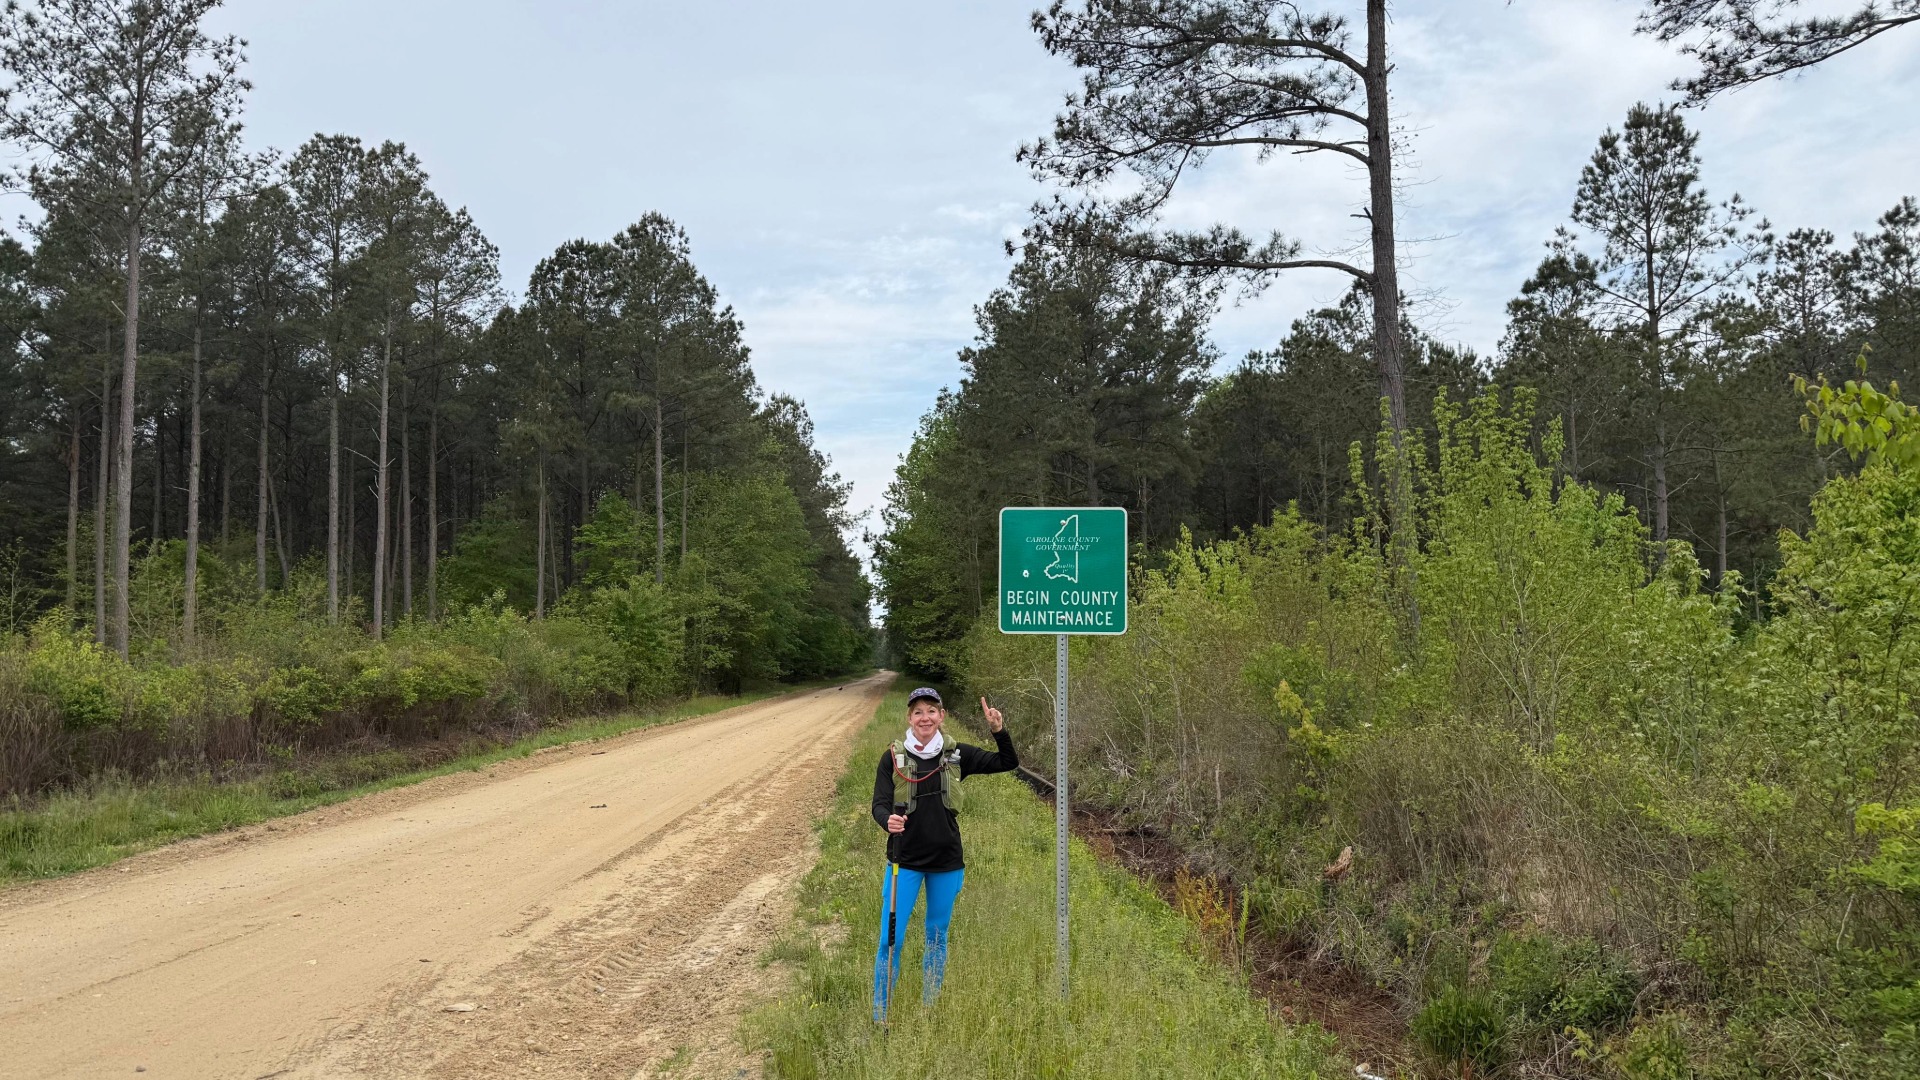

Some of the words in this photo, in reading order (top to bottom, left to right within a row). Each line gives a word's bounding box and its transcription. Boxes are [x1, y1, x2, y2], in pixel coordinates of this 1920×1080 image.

[1007, 590, 1050, 605] BEGIN
[1060, 590, 1119, 606] COUNTY
[1011, 610, 1114, 626] MAINTENANCE
